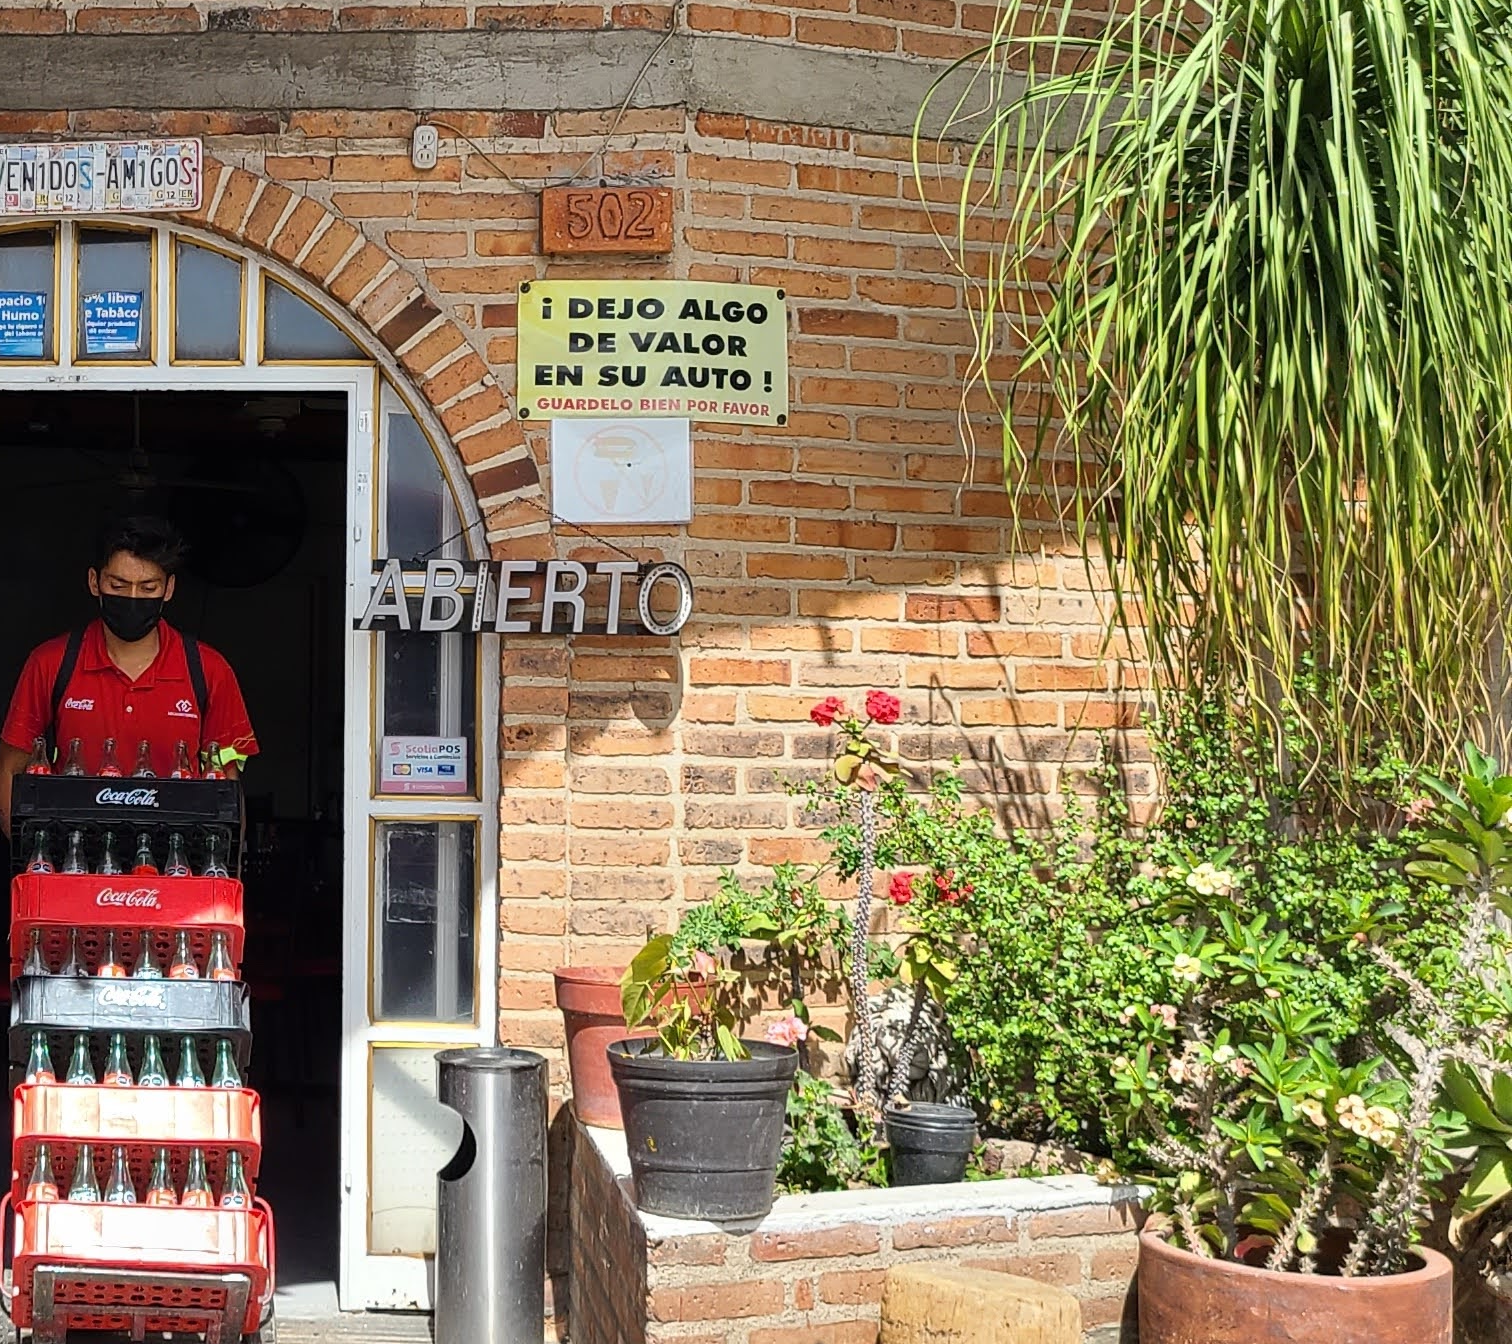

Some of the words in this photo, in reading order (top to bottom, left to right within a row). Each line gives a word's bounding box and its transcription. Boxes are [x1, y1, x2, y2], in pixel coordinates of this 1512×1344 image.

[567, 191, 655, 239] 502
[108, 292, 137, 304] libre
[2, 311, 39, 320] Humo
[568, 298, 665, 320] DEJO
[678, 298, 768, 324] ALGO
[568, 332, 616, 353] DE
[629, 332, 747, 357] VALOR
[534, 365, 583, 386] EN
[598, 366, 646, 387] SU
[660, 366, 751, 391] AUTO
[537, 398, 633, 411] GUARDELO
[640, 399, 681, 411] BIEN
[687, 400, 718, 413] POR
[723, 402, 769, 416] FAVOR
[359, 558, 694, 636] ABIERTO
[96, 787, 159, 805] Coca-Cola
[96, 887, 161, 907] Coca-Cola
